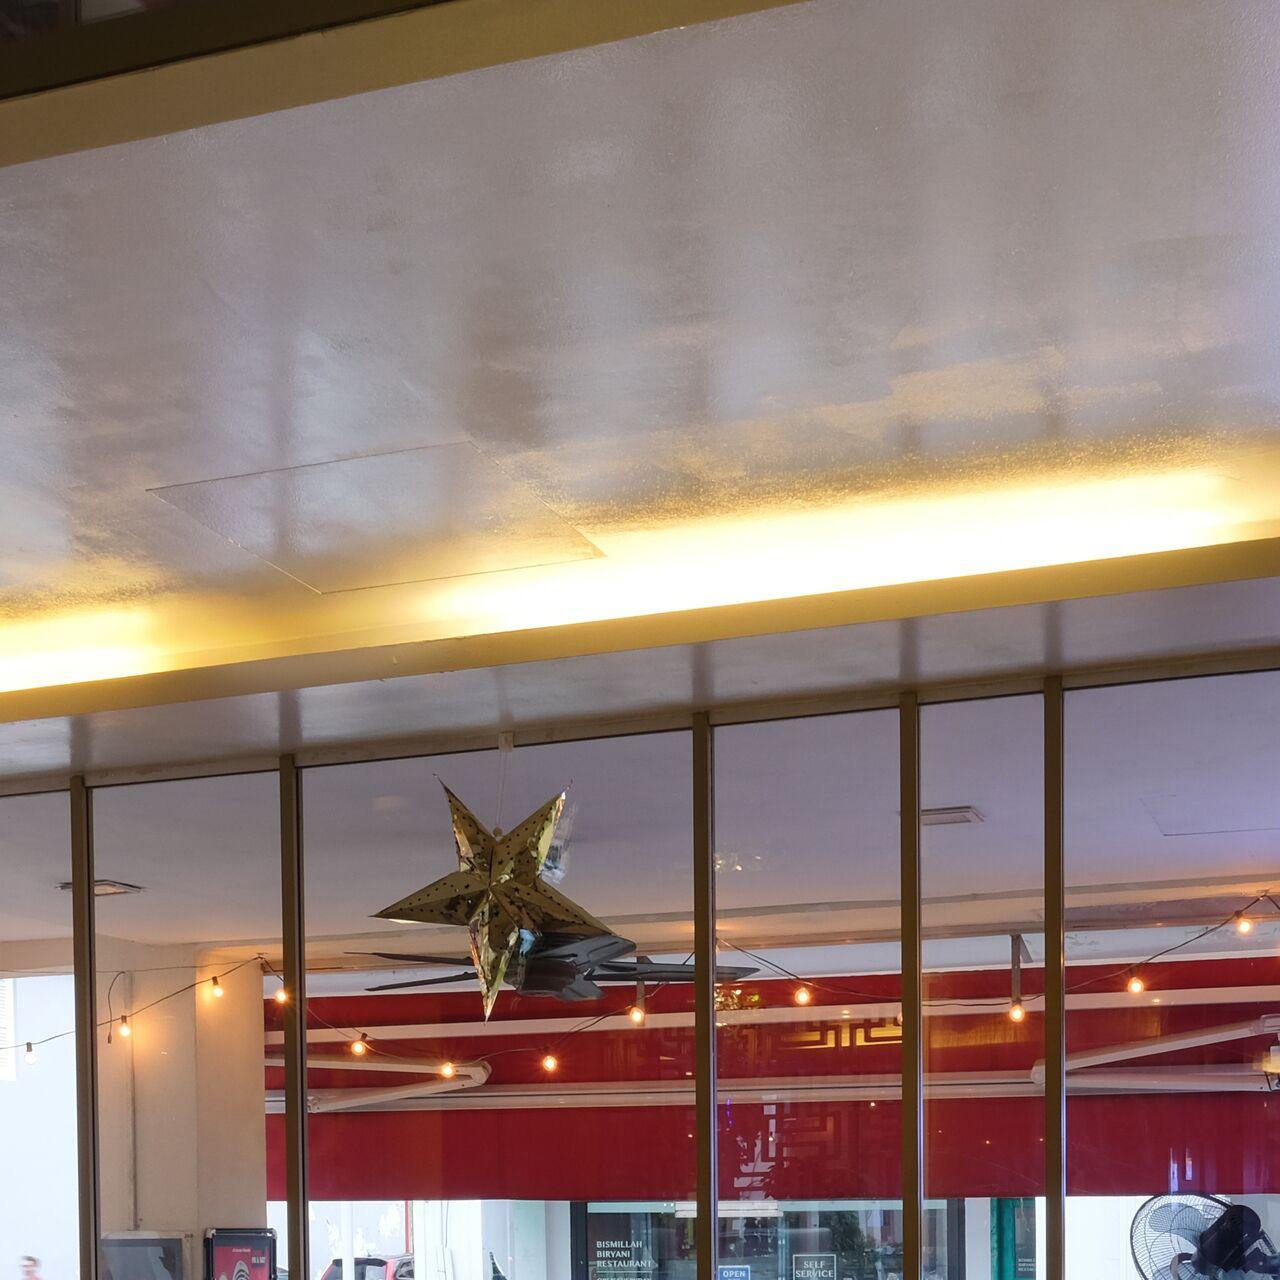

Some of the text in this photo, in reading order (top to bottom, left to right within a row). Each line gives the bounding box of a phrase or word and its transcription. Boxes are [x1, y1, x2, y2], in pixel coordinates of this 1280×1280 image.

[596, 1250, 630, 1258] BIRYANI
[596, 1260, 652, 1268] RESTAURANT
[803, 1260, 826, 1269] SELF
[722, 1270, 746, 1278] OPEN
[795, 1269, 835, 1278] SERVICE
